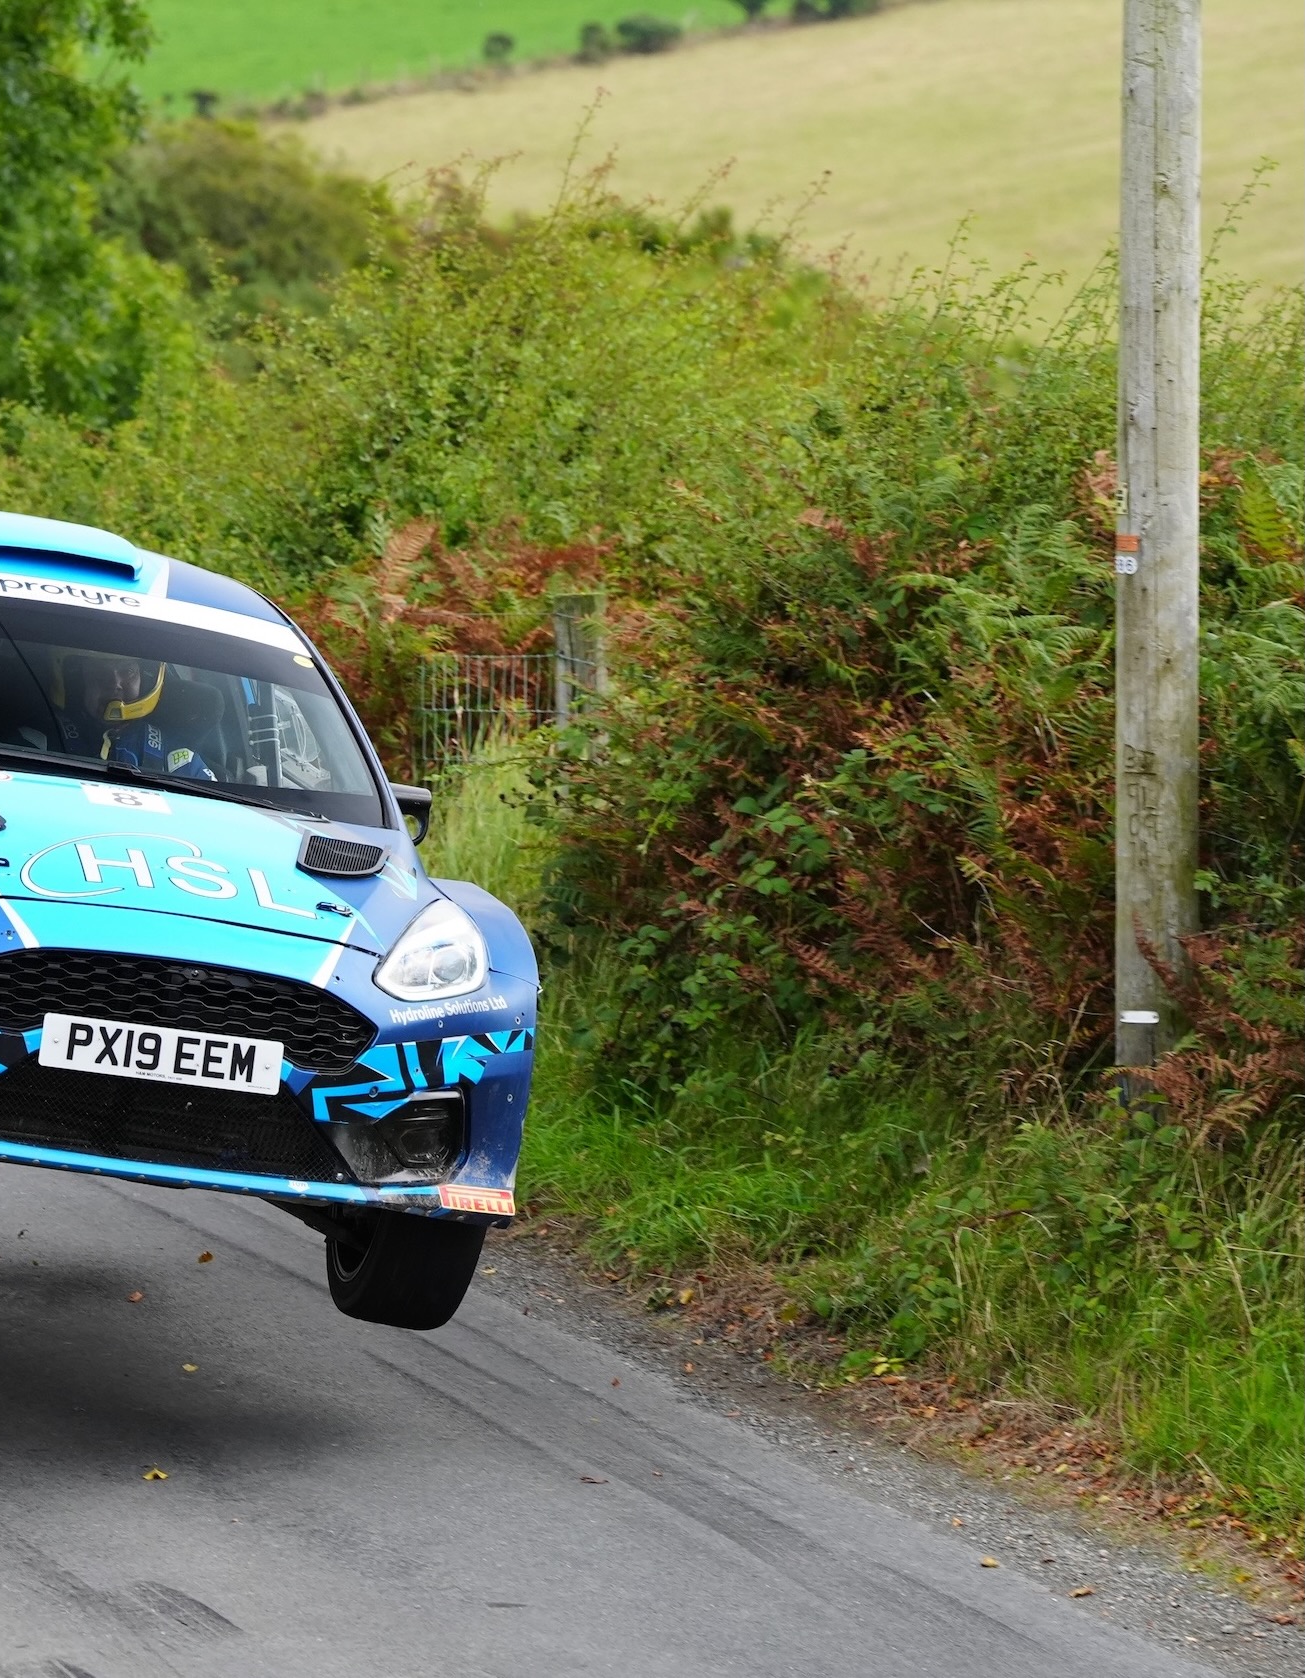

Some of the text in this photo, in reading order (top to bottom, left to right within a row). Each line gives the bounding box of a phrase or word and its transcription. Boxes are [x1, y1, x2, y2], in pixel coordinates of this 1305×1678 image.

[112, 791, 144, 806] 8
[74, 842, 318, 919] HSL
[389, 995, 508, 1025] Hydroline Solutions Ltd
[66, 1022, 256, 1083] PX19 EEM
[439, 1184, 514, 1214] PIRELLI
